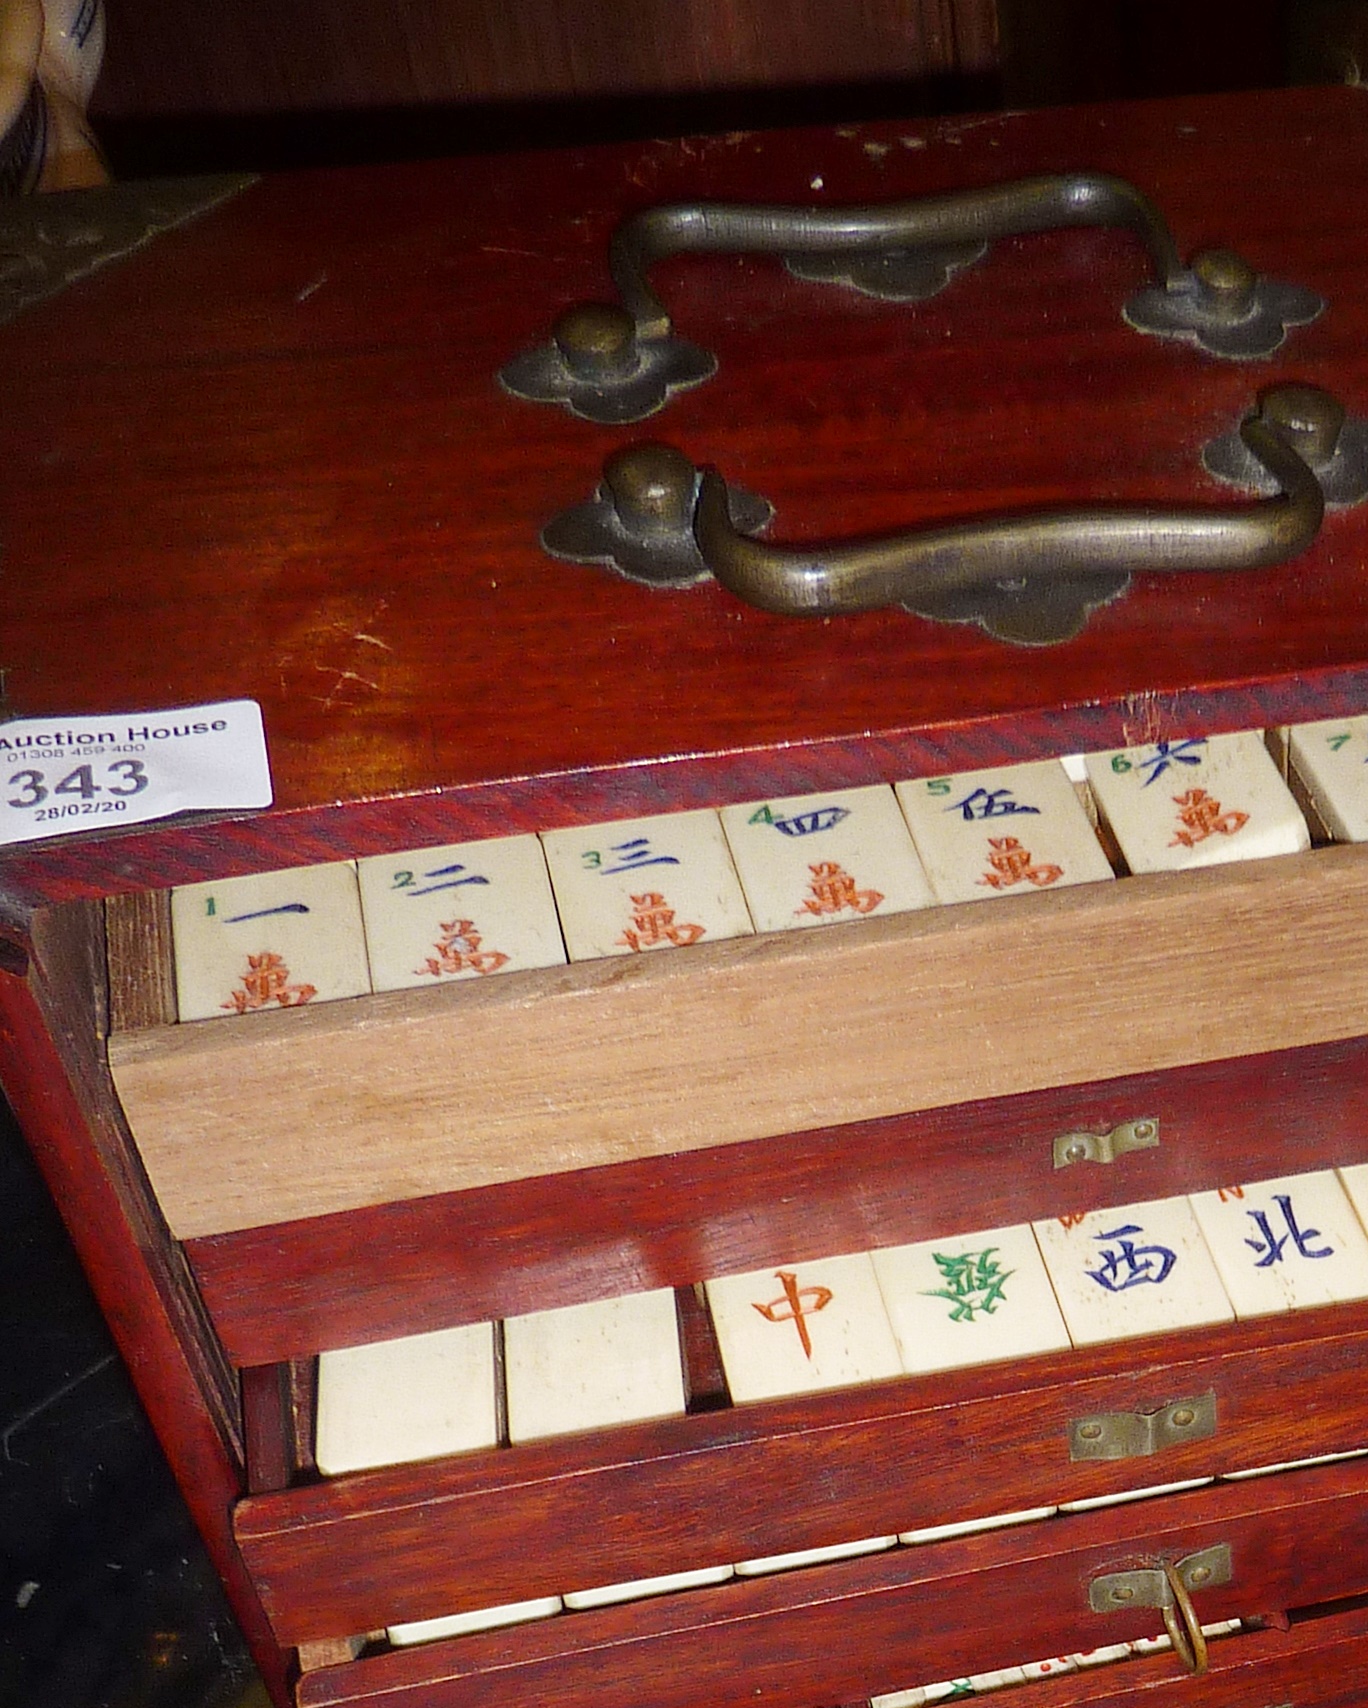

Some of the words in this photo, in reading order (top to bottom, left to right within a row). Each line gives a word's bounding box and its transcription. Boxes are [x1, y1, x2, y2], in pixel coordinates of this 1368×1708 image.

[0, 730, 116, 750] Auction
[127, 719, 228, 742] House
[1111, 754, 1133, 774] 6
[1138, 738, 1210, 789] 六
[7, 759, 150, 809] 343
[926, 778, 952, 796] 5
[34, 800, 127, 822] 28/02/20
[748, 804, 784, 826] 4
[774, 806, 852, 838] 四
[582, 851, 601, 869] 3
[600, 839, 680, 875] 三
[392, 870, 416, 890] 2
[407, 864, 491, 896] 二
[1244, 1195, 1335, 1267] 北
[1085, 1224, 1178, 1292] 西
[752, 1270, 833, 1360] 中
